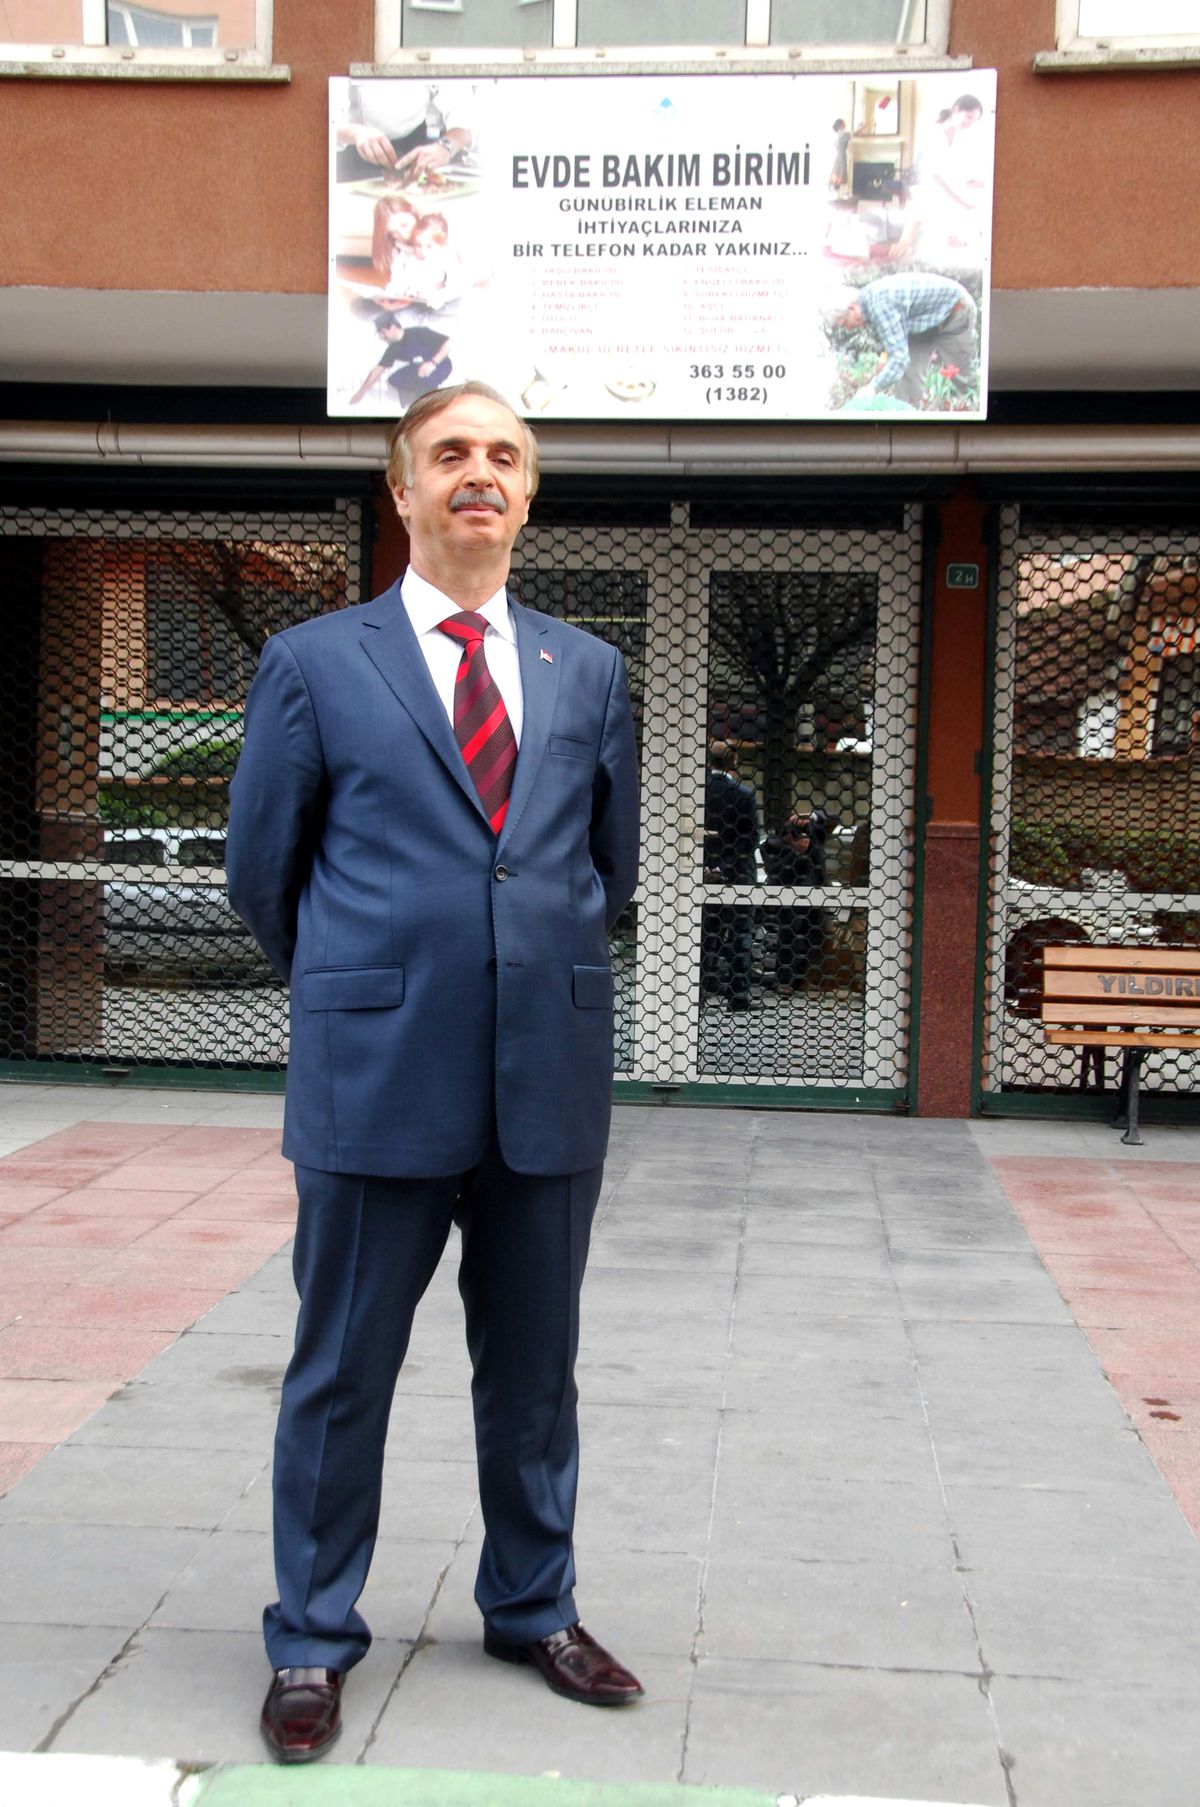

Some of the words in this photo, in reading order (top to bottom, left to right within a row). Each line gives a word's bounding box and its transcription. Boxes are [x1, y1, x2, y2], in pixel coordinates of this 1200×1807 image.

[512, 155, 591, 188] EVDE
[602, 153, 701, 188] BAKIM
[712, 143, 811, 187] BİRİMİ
[559, 194, 677, 212] GÜNÜBİRLİK
[685, 196, 763, 211] ELEMAN
[578, 218, 743, 237] İHTİYAÇLARINIZA
[513, 242, 544, 257] BİR
[551, 243, 635, 257] TELEFON
[642, 243, 707, 257] KADAR
[714, 242, 808, 256] YAKINIZ...
[689, 364, 724, 379] 363
[732, 364, 755, 379] 55
[762, 364, 786, 379] 00
[705, 387, 768, 405] (1382)
